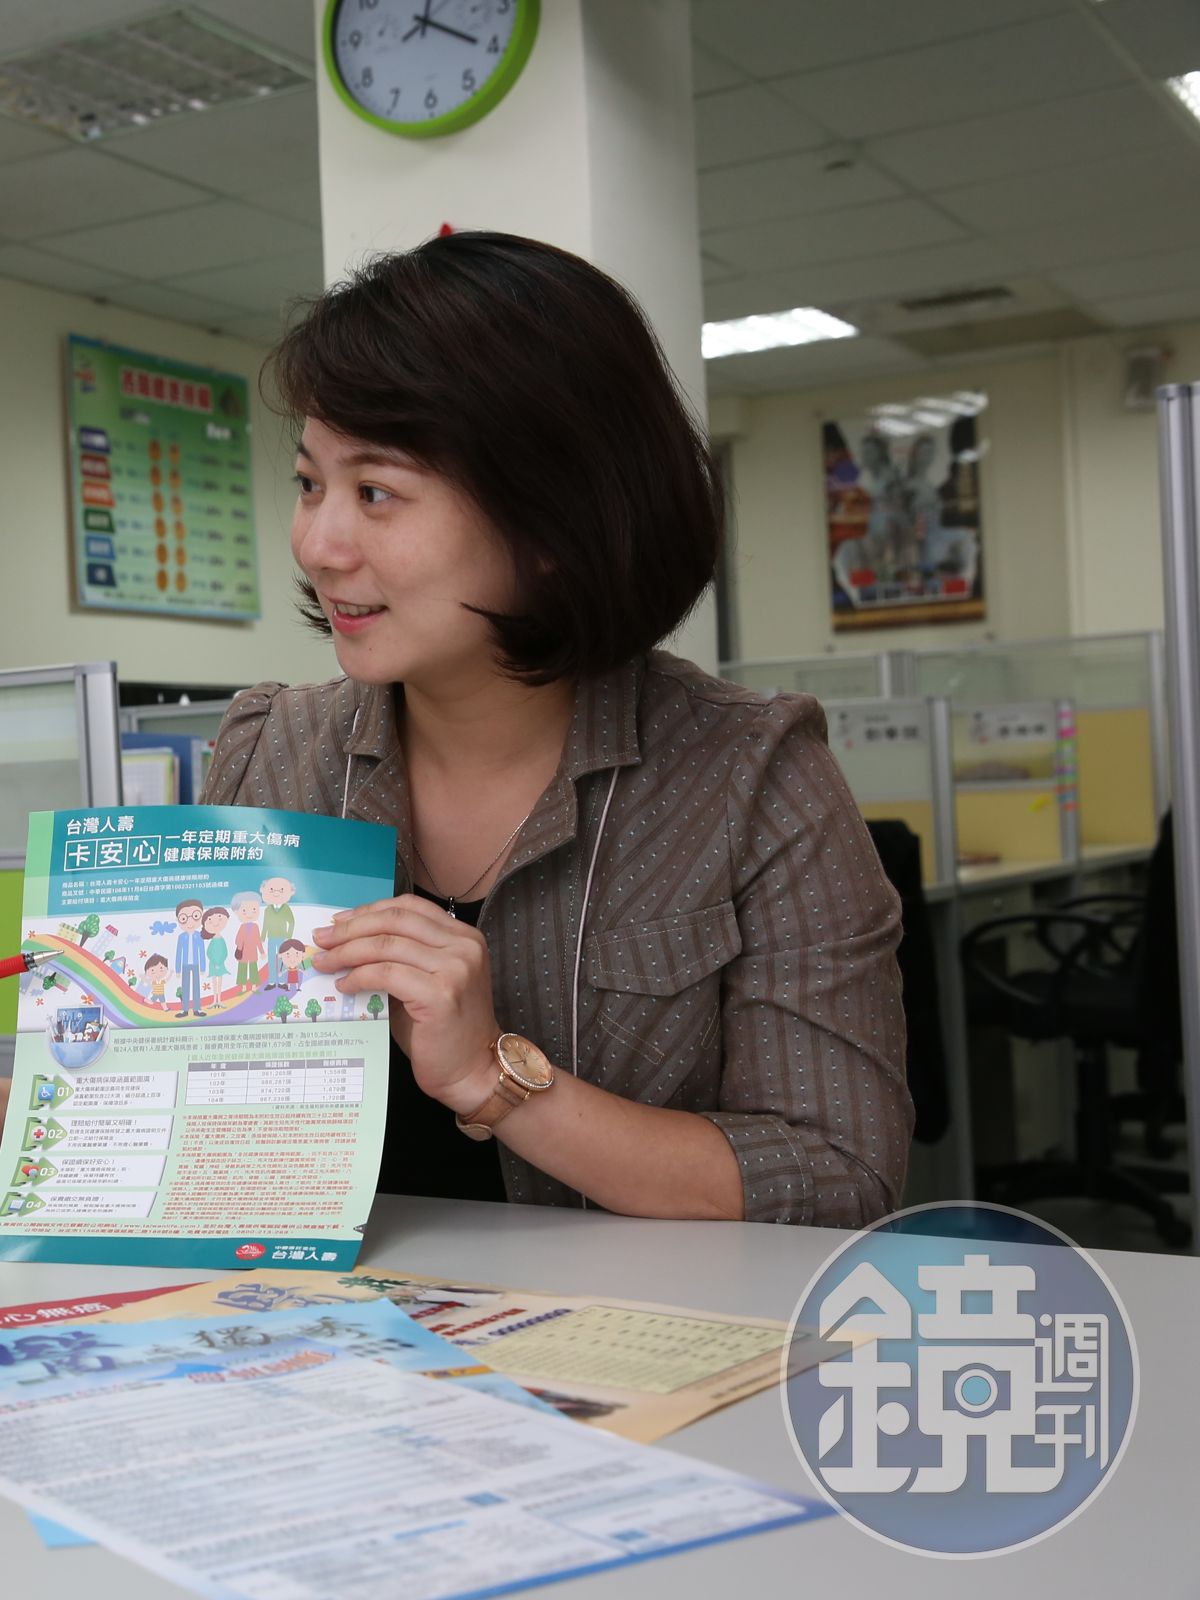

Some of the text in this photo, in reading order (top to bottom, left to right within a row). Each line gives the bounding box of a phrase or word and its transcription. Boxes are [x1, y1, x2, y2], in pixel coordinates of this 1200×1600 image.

[349, 30, 362, 49] 9
[487, 34, 499, 53] 4
[361, 67, 374, 88] 8
[462, 69, 475, 91] 5
[390, 88, 401, 109] 7
[424, 89, 438, 109] 6
[66, 815, 135, 836] 台灣人壽
[165, 829, 300, 848] 一年定期重大傷病
[67, 840, 157, 867] 卡安心
[163, 846, 264, 862] 健康保險附約
[57, 1087, 70, 1097] 01
[47, 1129, 63, 1139] 02
[40, 1168, 56, 1176] 03
[272, 1251, 338, 1262] 台灣人壽
